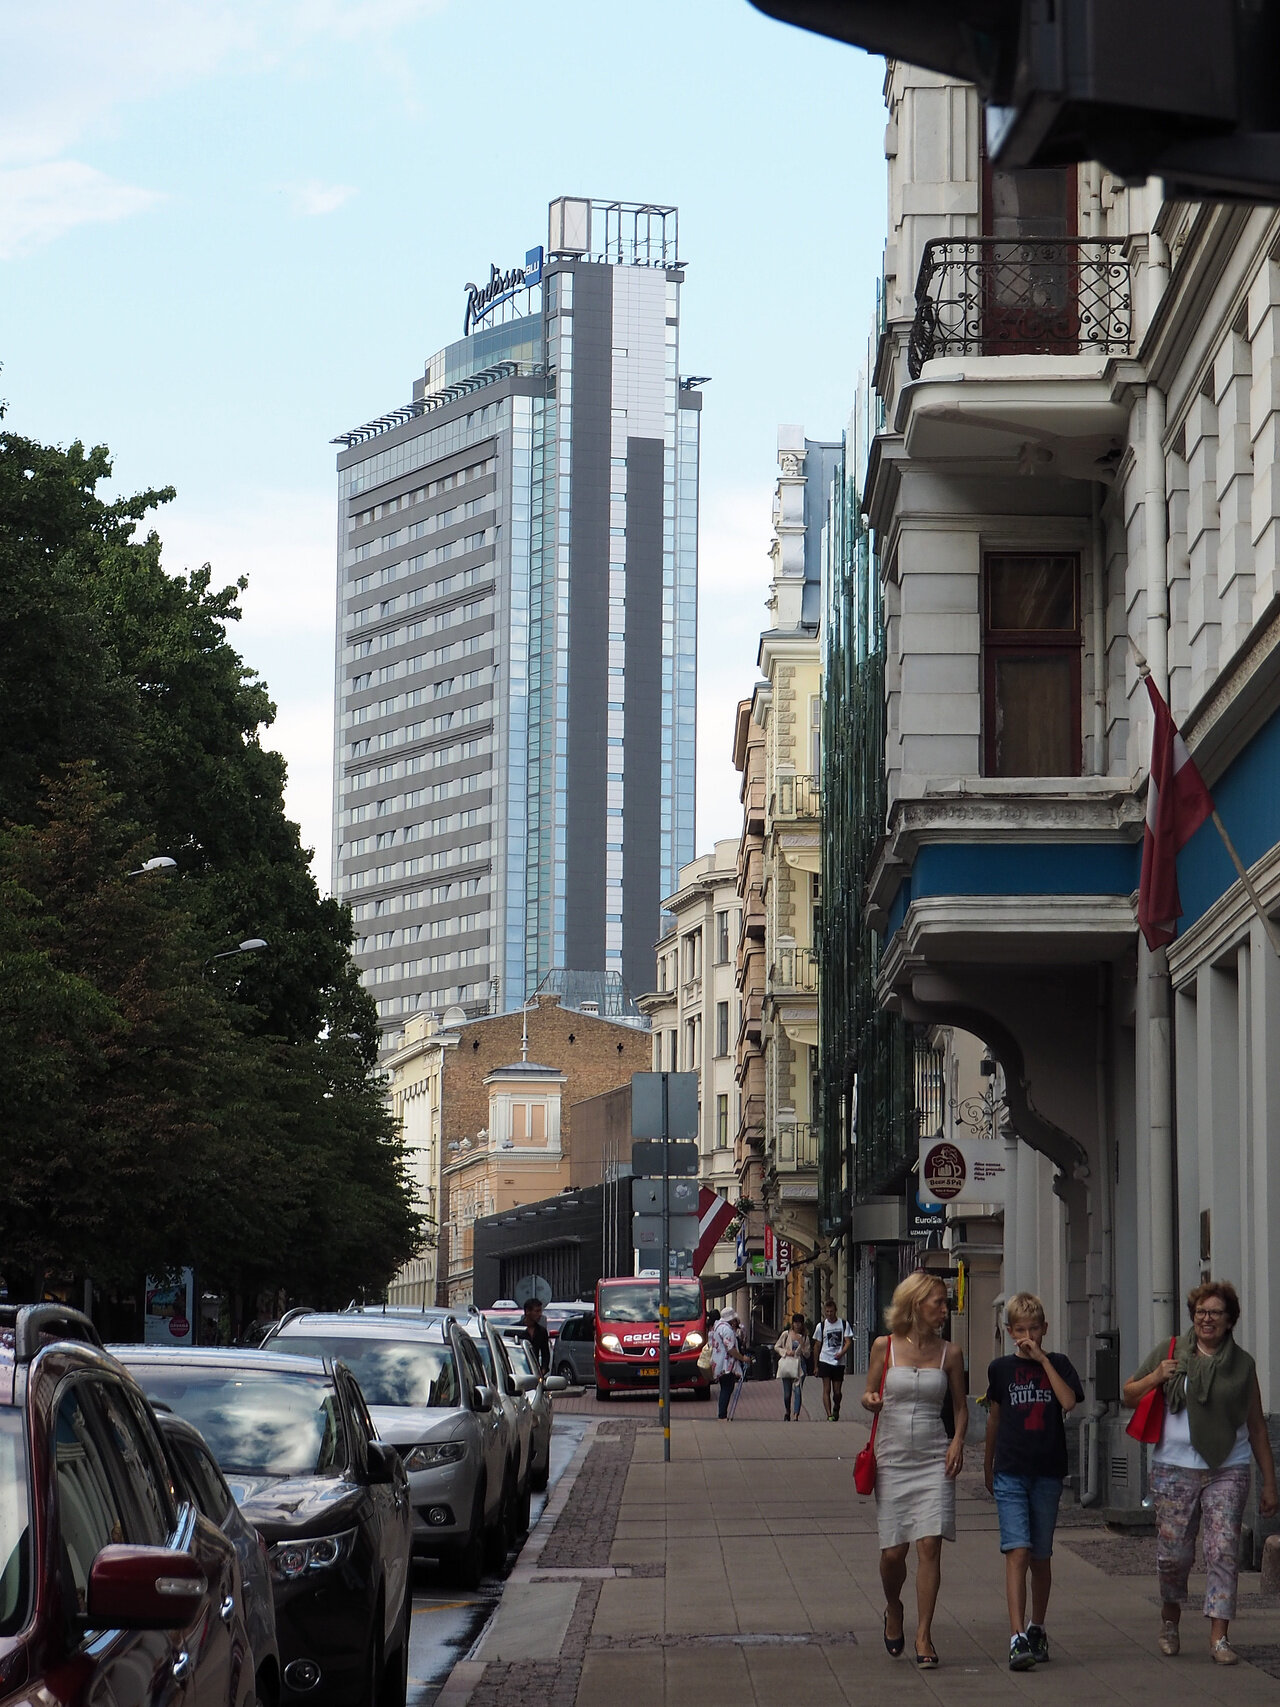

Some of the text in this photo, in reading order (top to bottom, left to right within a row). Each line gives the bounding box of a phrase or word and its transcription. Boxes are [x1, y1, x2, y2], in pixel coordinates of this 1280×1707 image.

[464, 261, 539, 336] Radisson BLU
[1008, 1380, 1035, 1392] Coach
[1010, 1389, 1052, 1406] RULES
